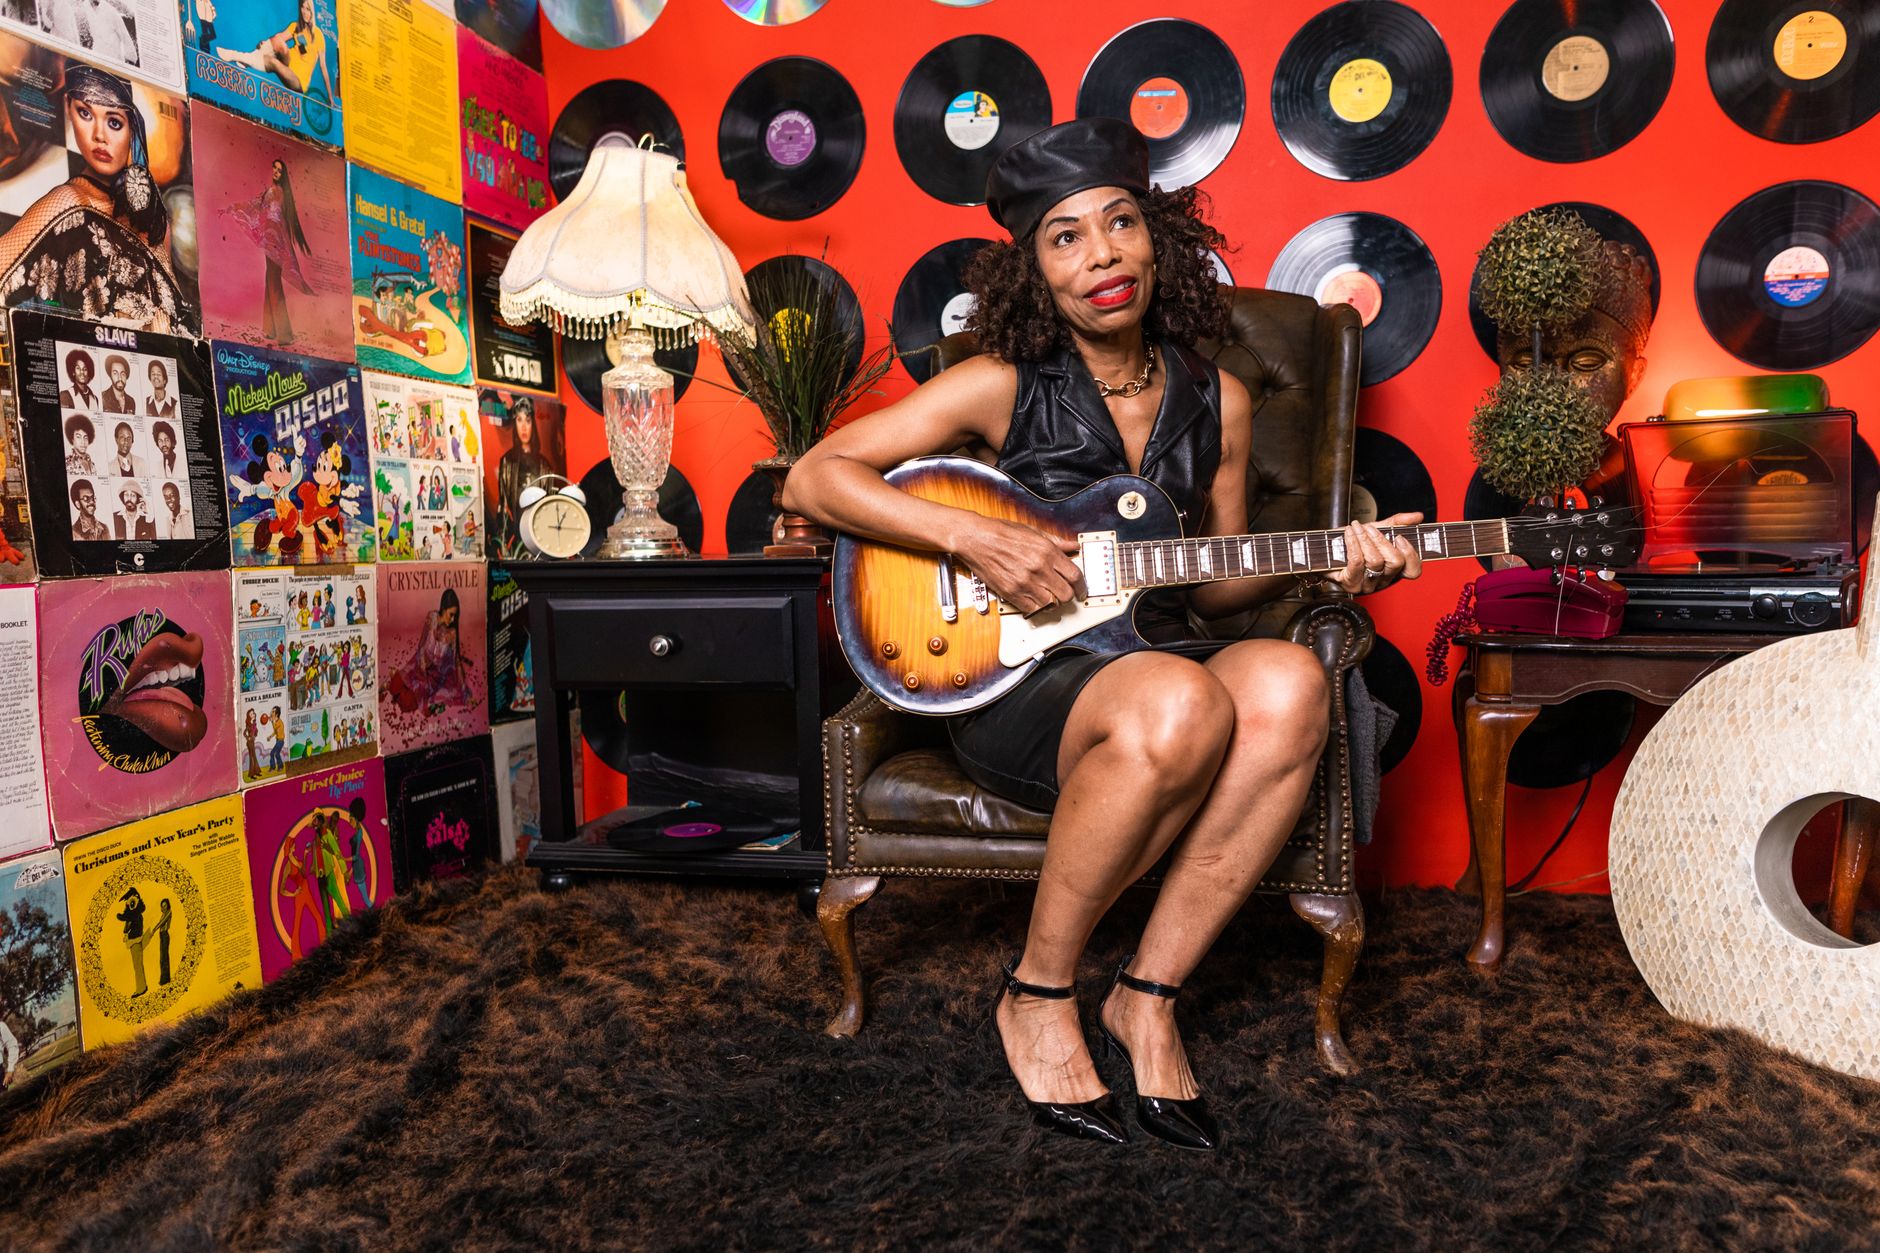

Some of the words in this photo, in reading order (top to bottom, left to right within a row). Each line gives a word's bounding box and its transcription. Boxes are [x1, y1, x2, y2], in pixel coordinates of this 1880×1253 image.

[196, 53, 257, 101] ROBERTO
[260, 81, 302, 126] BARRY
[355, 193, 388, 224] Hansel
[399, 209, 426, 238] Gretel
[95, 325, 138, 349] SLAVE
[224, 384, 271, 416] Mickey
[275, 378, 350, 442] DISCO
[388, 570, 441, 592] CRYSTAL
[443, 569, 478, 589] GAYLE
[81, 607, 165, 703] Rufus
[113, 752, 143, 775] Chaka
[142, 751, 170, 772] Khan
[74, 850, 130, 875] Christmas
[131, 839, 152, 854] and
[151, 834, 176, 848] New
[176, 823, 205, 839] Year's
[207, 815, 235, 830] Party
[190, 847, 208, 858] Singers
[208, 844, 217, 852] and
[218, 837, 240, 850] Orchestra
